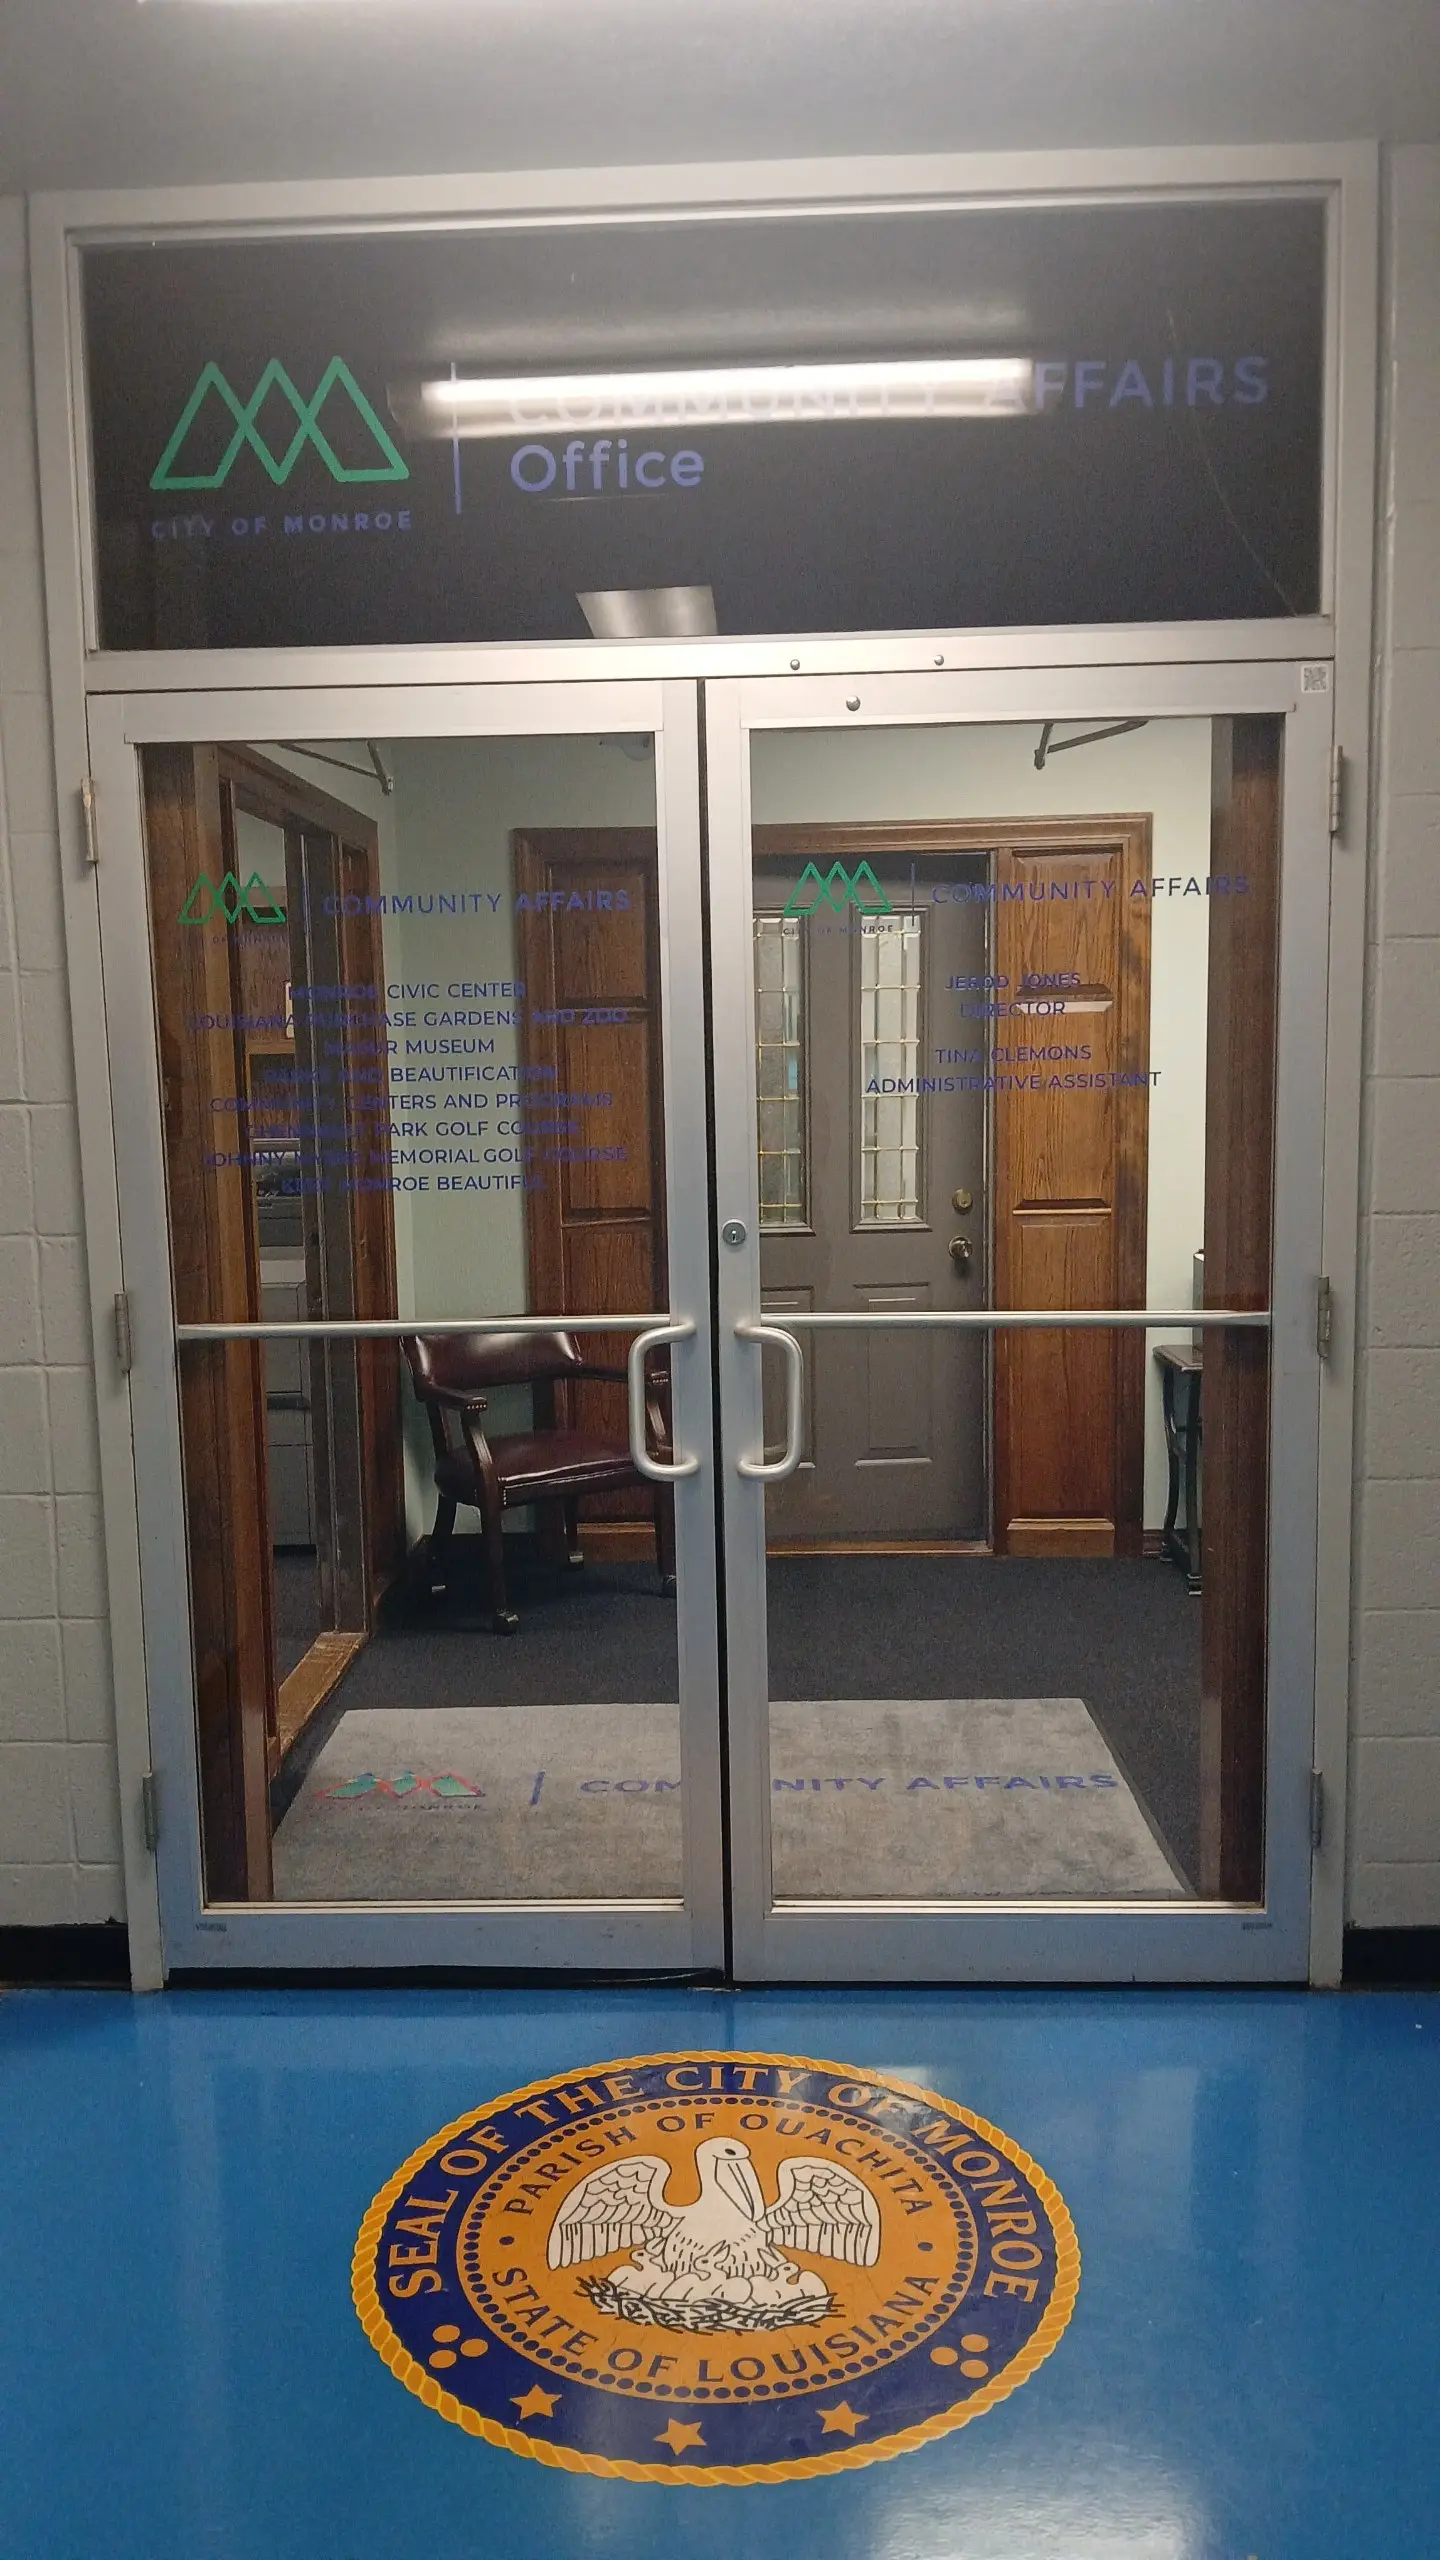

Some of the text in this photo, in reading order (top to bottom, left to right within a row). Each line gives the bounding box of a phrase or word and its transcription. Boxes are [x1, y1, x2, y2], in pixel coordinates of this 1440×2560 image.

[983, 356, 1269, 413] AFFAIRS
[510, 439, 705, 493] Office
[151, 510, 412, 539] CITY OF MONROE
[932, 875, 1250, 905] COMMUNITY AFFAIRS
[322, 889, 632, 915] COMMUNITY AFFAIRS
[387, 983, 440, 999] CIVIC
[447, 981, 525, 998] CENTER
[1017, 972, 1081, 989] JONES
[423, 1010, 521, 1027] GARDENS
[406, 1037, 495, 1055] MUSEUM
[934, 1045, 1093, 1065] TINA CLEMONS
[865, 1071, 1162, 1094] ADMINISTRATIVE ASSISTANT
[444, 1092, 488, 1109] AND
[375, 1121, 429, 1138] PARK
[435, 1120, 489, 1137] GOLF
[369, 1147, 479, 1165] MEMORIAL
[579, 1773, 1119, 1794] COMNITY AFFAIRS
[502, 2111, 934, 2217] PARISH OF OUACHITA
[388, 2065, 1044, 2305] SEAL OF THE CITY OF MONROE
[490, 2266, 940, 2385] STATE OF LOUISIANA
